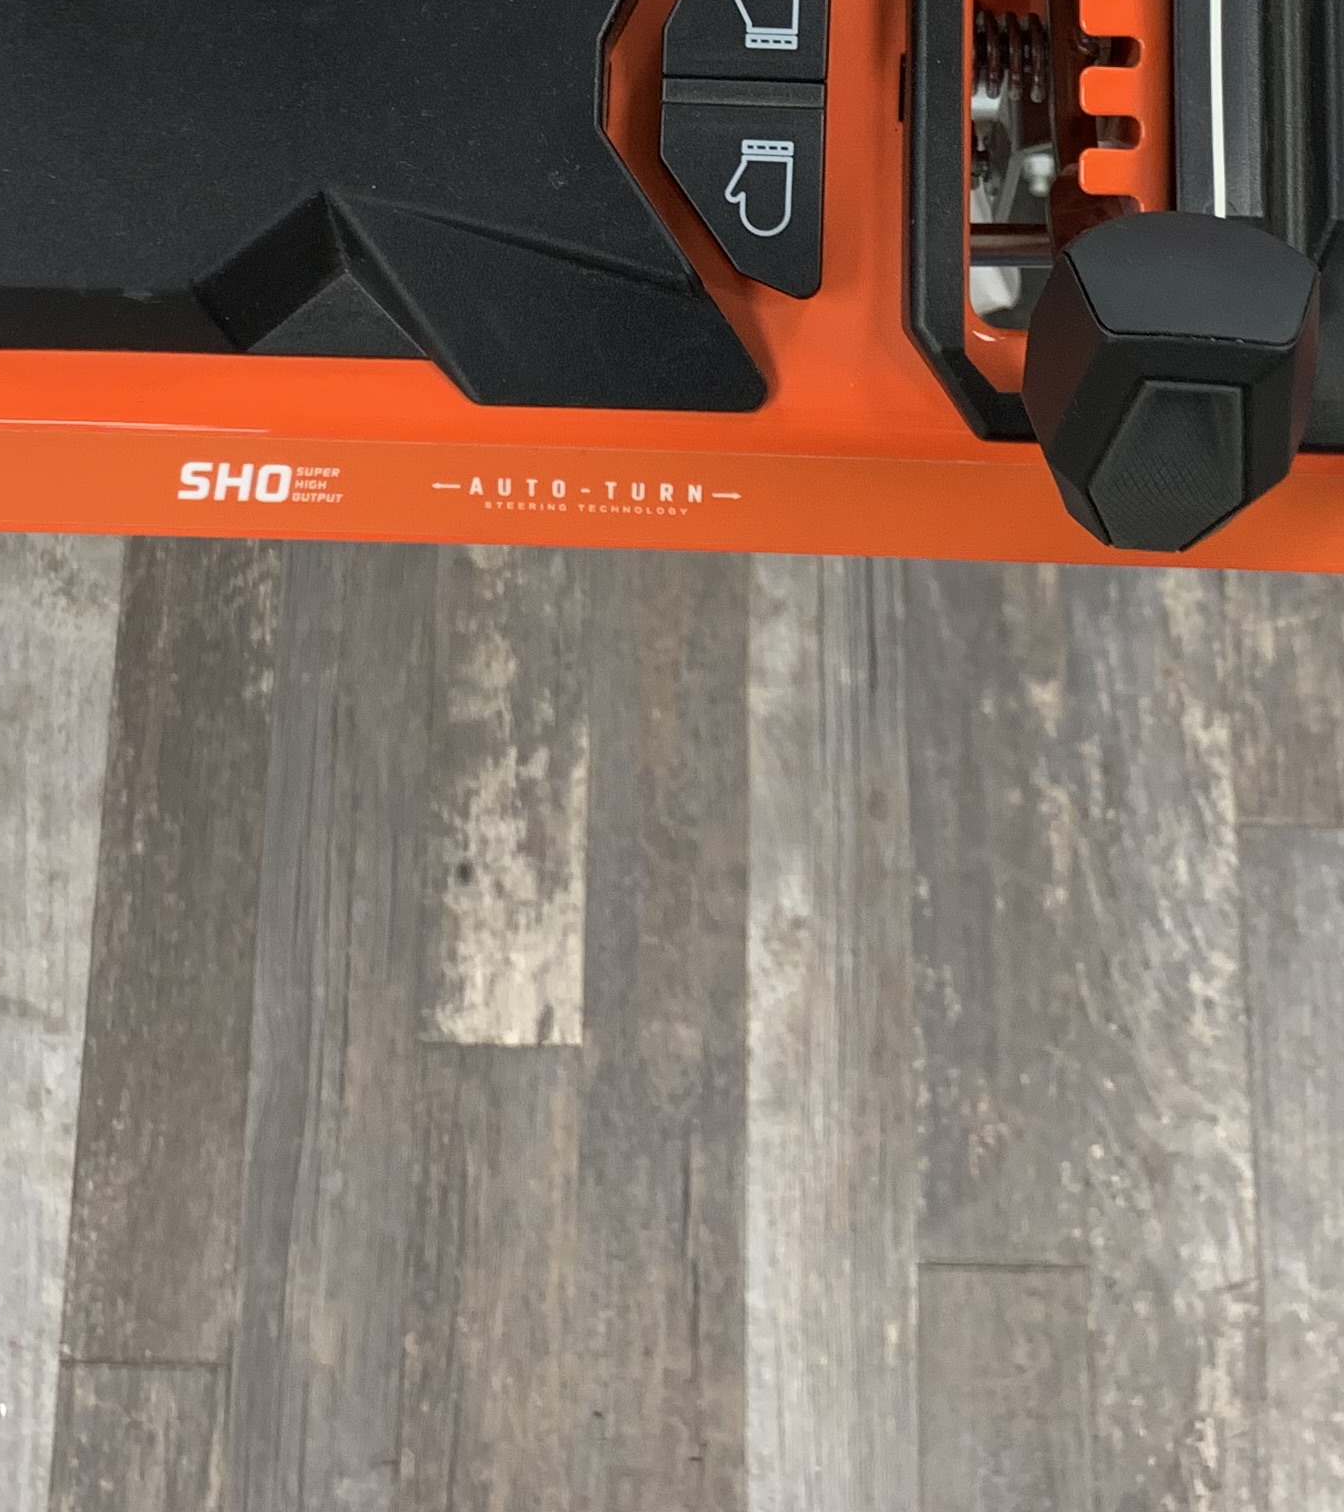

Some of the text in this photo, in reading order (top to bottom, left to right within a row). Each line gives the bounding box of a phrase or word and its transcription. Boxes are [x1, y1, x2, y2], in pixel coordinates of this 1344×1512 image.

[296, 466, 341, 478] SUPER
[177, 461, 293, 503] SHO
[294, 479, 328, 490] HIGH
[291, 491, 344, 503] OUTPUT
[484, 501, 689, 516] STEERING TECHNOLOGY
